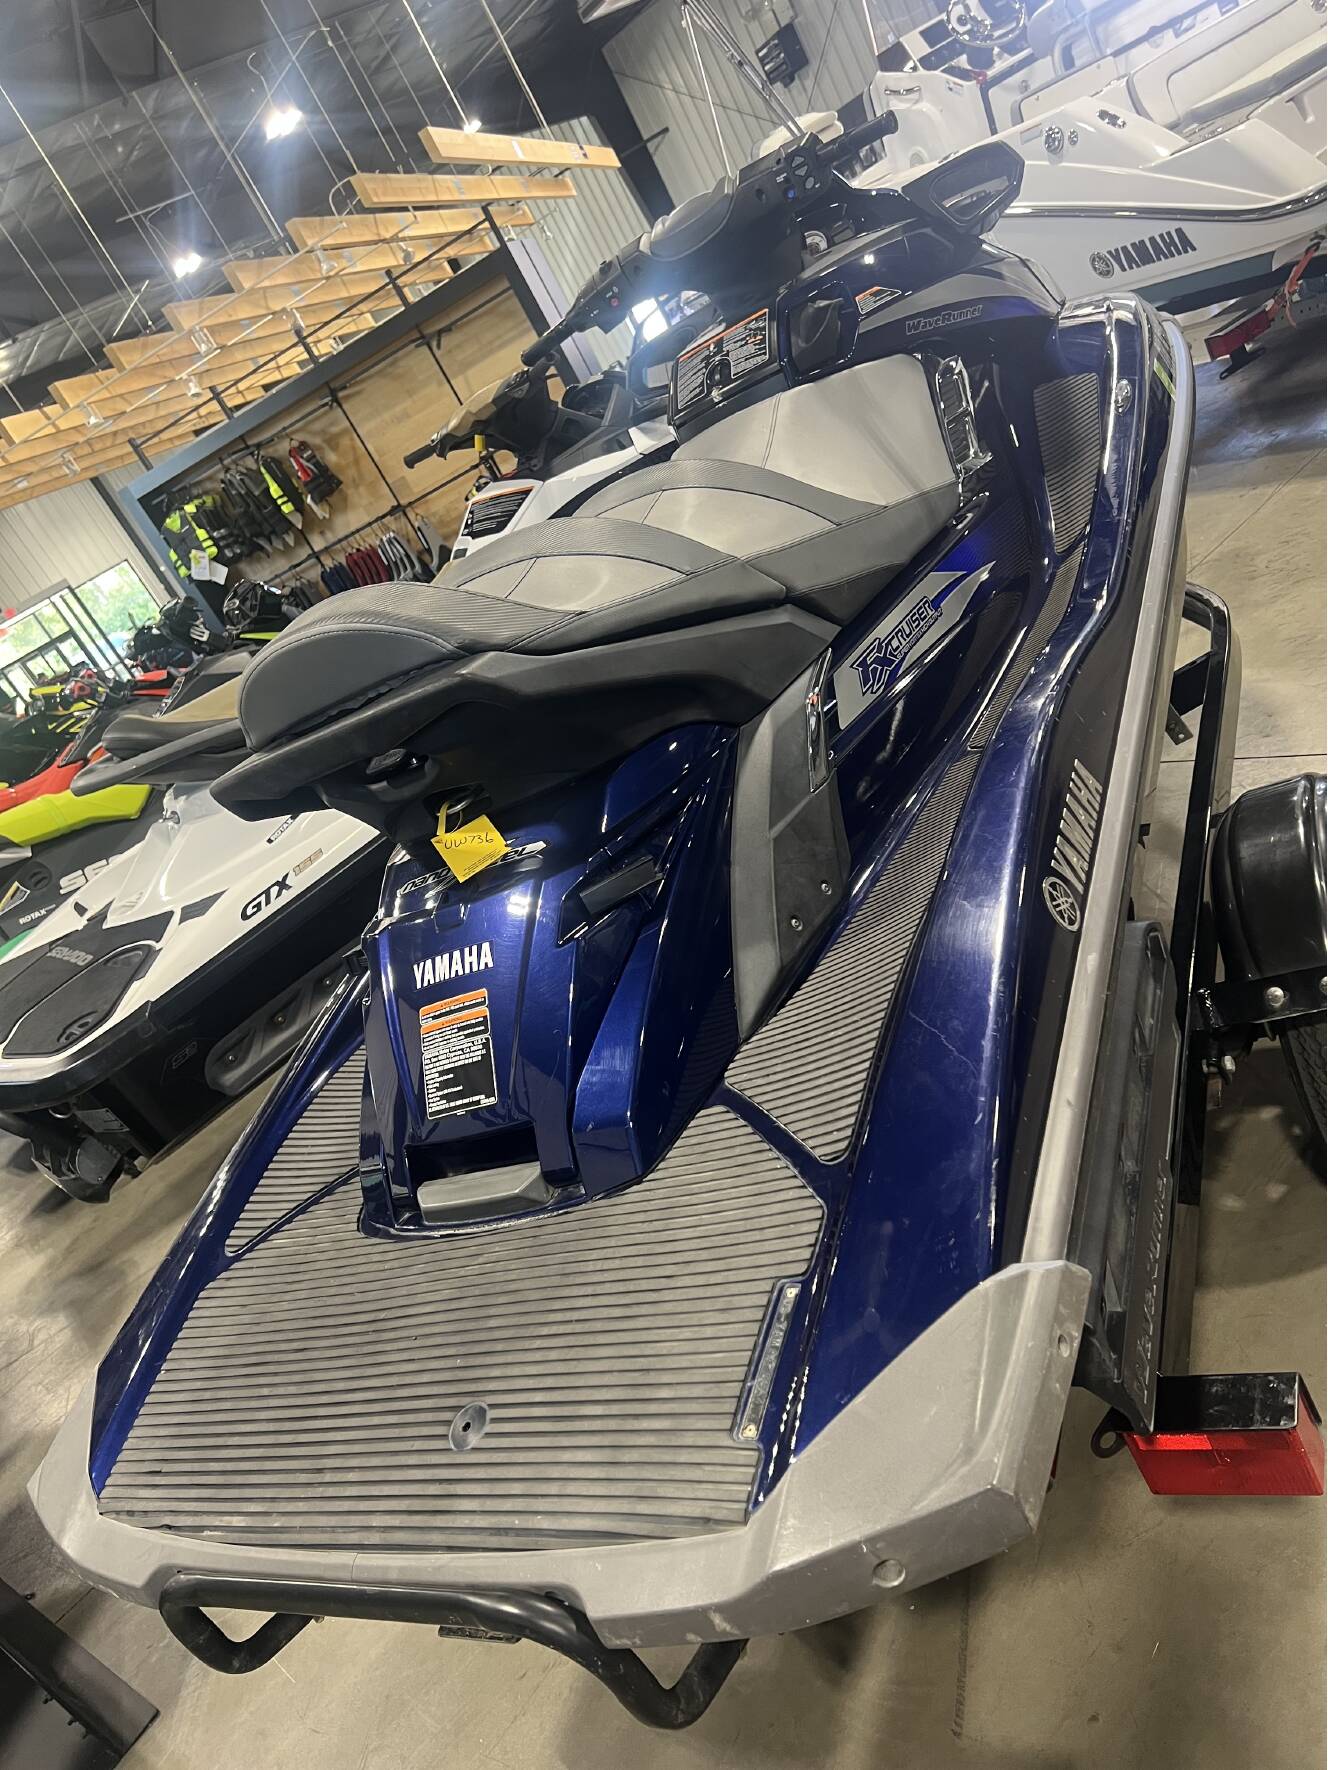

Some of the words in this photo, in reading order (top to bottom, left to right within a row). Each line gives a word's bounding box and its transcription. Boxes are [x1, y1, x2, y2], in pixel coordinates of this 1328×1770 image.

[1106, 227, 1197, 272] YAMAHA
[906, 305, 983, 335] WaveRunner
[850, 638, 898, 696] FX
[886, 597, 936, 659] CRUISER
[1051, 759, 1103, 895] YAMAHA
[18, 908, 47, 925] ROTAX
[240, 870, 293, 921] GTX
[413, 941, 494, 990] YAMAHA
